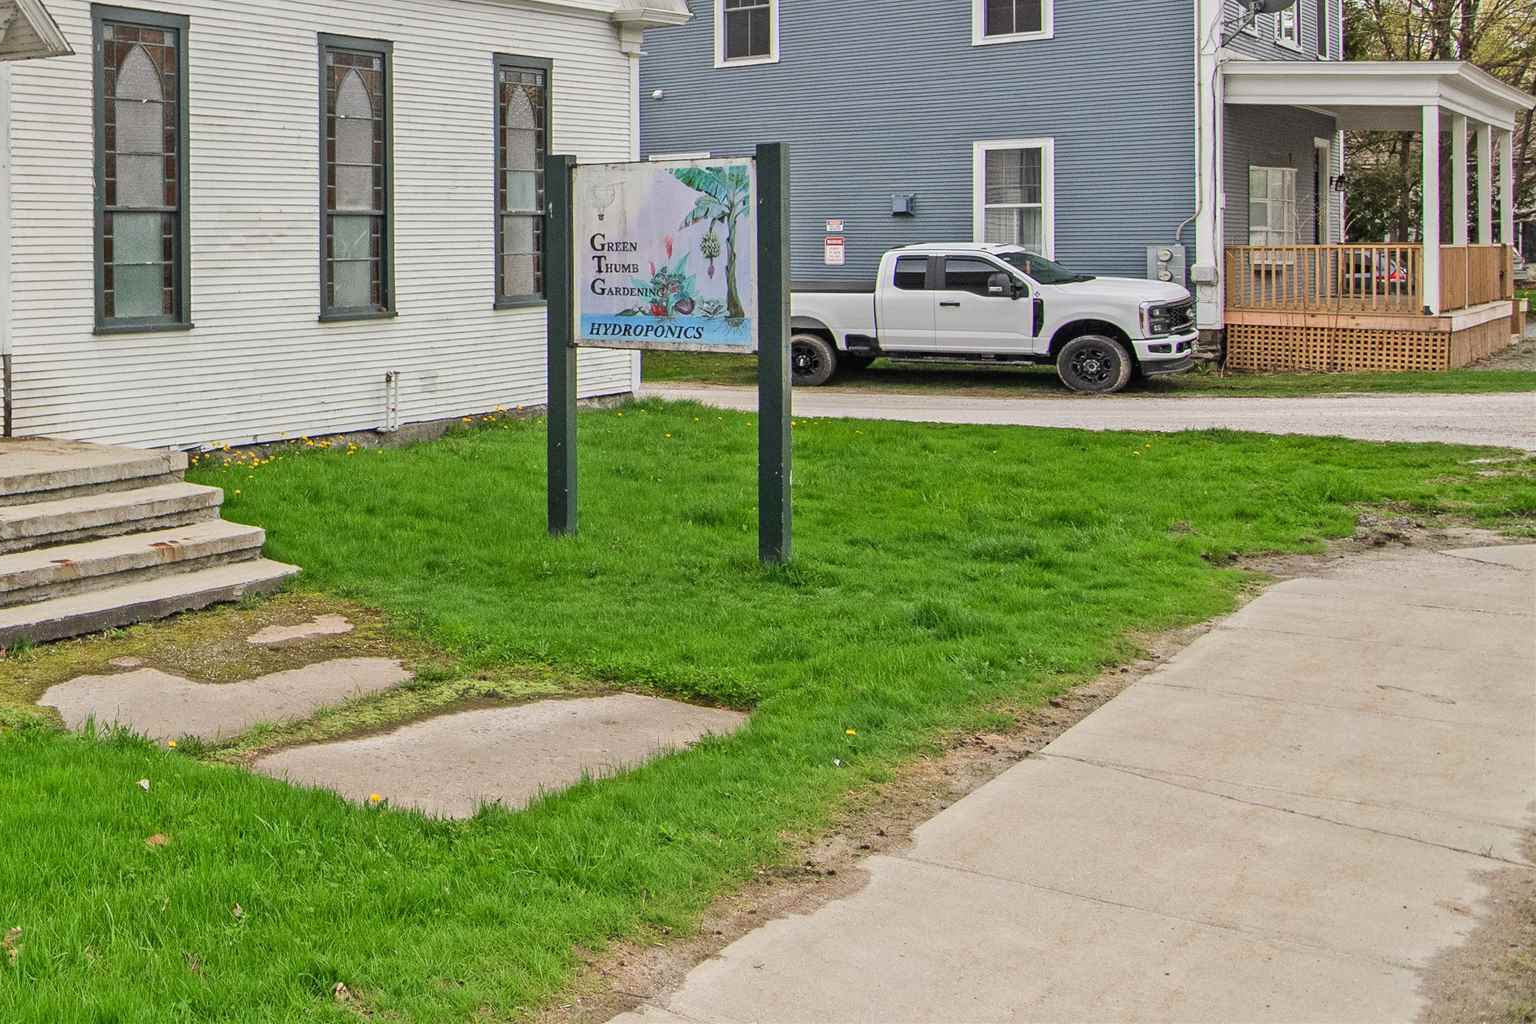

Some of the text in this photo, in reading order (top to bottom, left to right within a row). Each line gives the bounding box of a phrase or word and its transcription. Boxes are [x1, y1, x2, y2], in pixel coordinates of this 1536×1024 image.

[590, 233, 638, 252] GREEN
[592, 255, 639, 274] THUMB
[590, 278, 665, 297] GARDENING
[589, 322, 704, 340] HYDROPONICS
